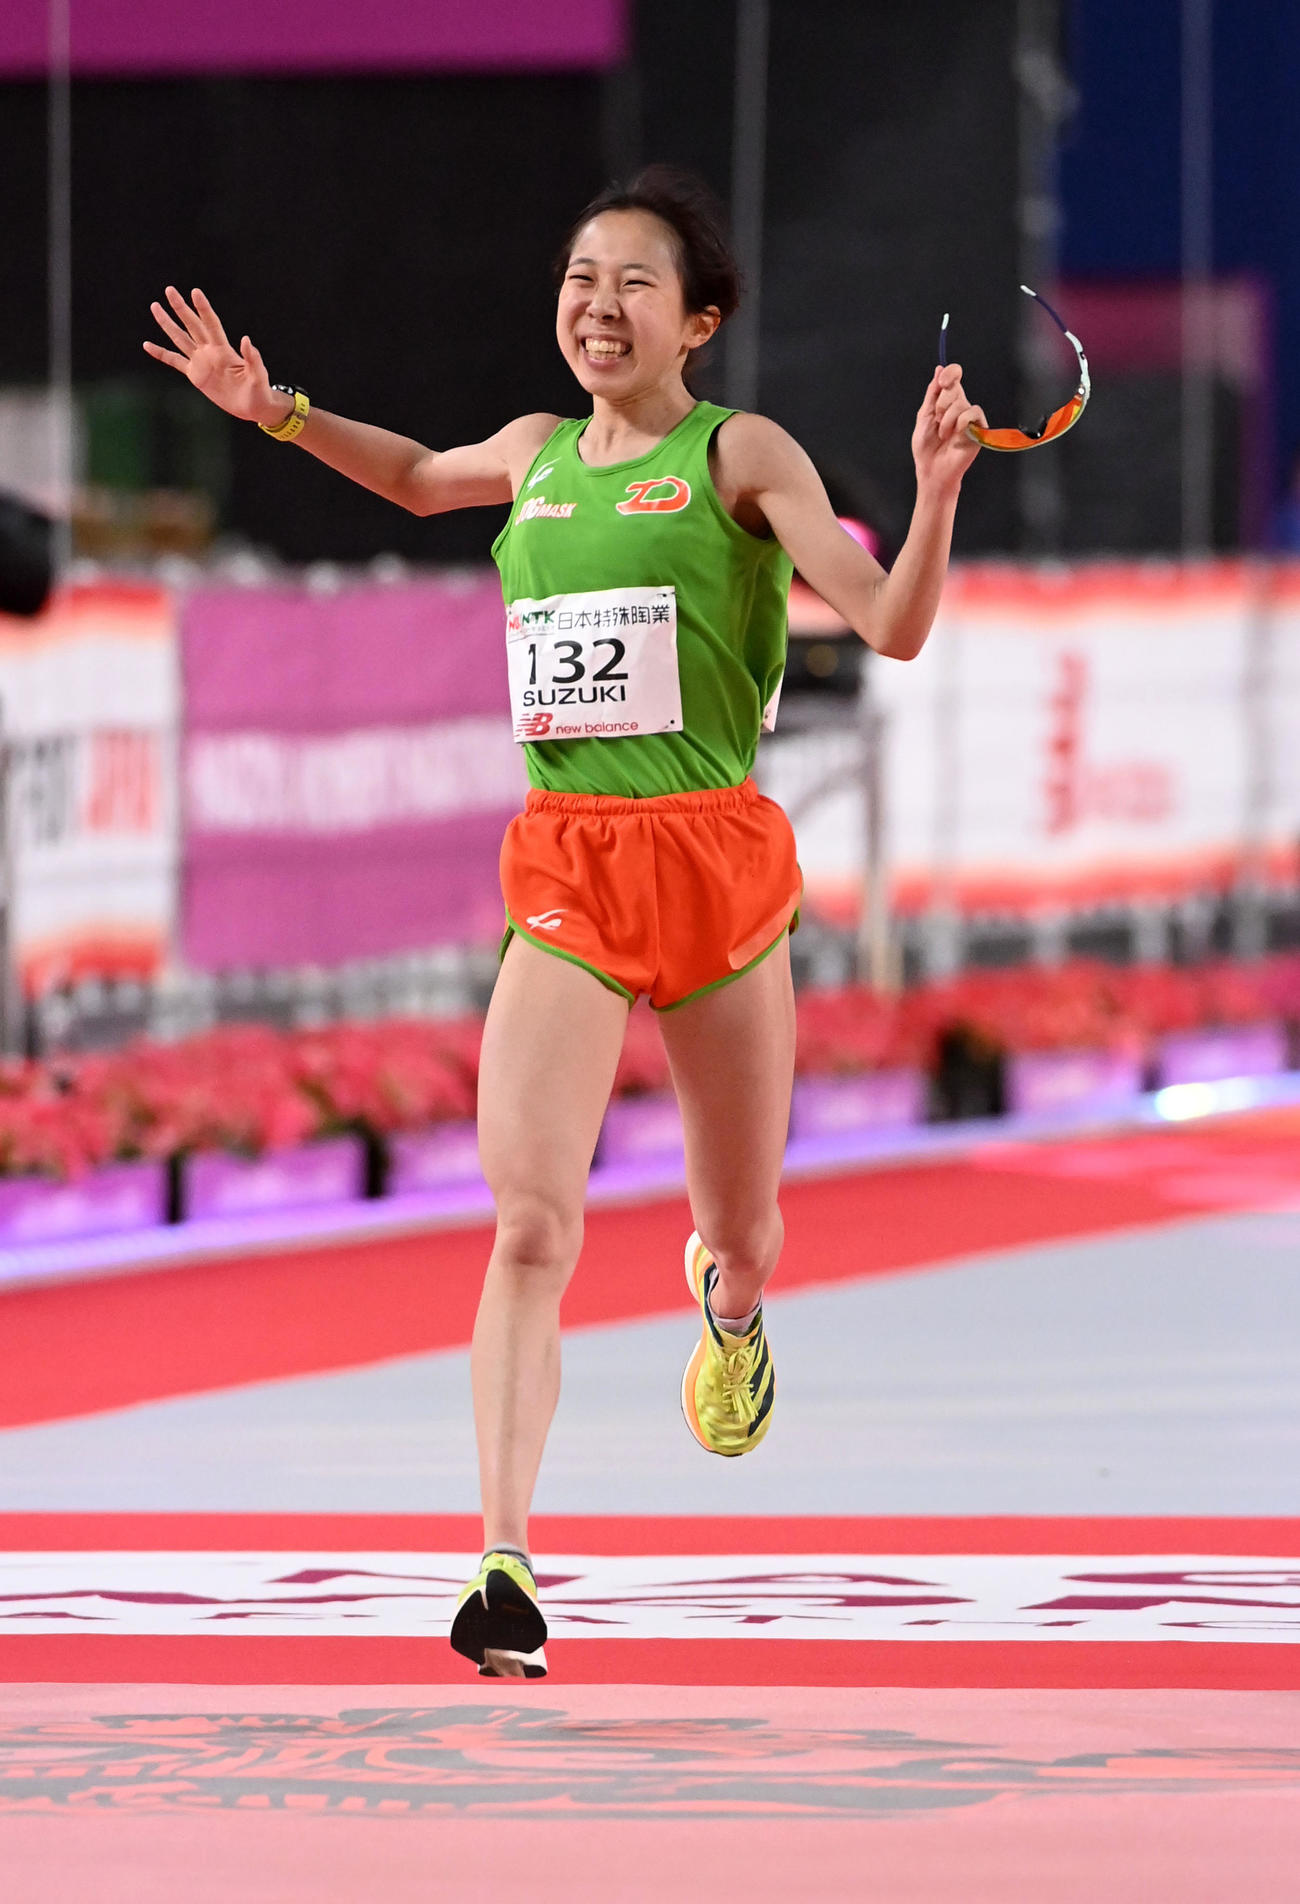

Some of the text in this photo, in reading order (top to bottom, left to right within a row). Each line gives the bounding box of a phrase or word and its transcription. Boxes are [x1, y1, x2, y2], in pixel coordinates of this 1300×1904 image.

[522, 610, 555, 626] NTK
[558, 603, 670, 630] 日本特殊陶業
[528, 638, 628, 685] 132
[523, 685, 626, 707] SUZUKI
[556, 724, 581, 735] new
[585, 721, 639, 734] balance
